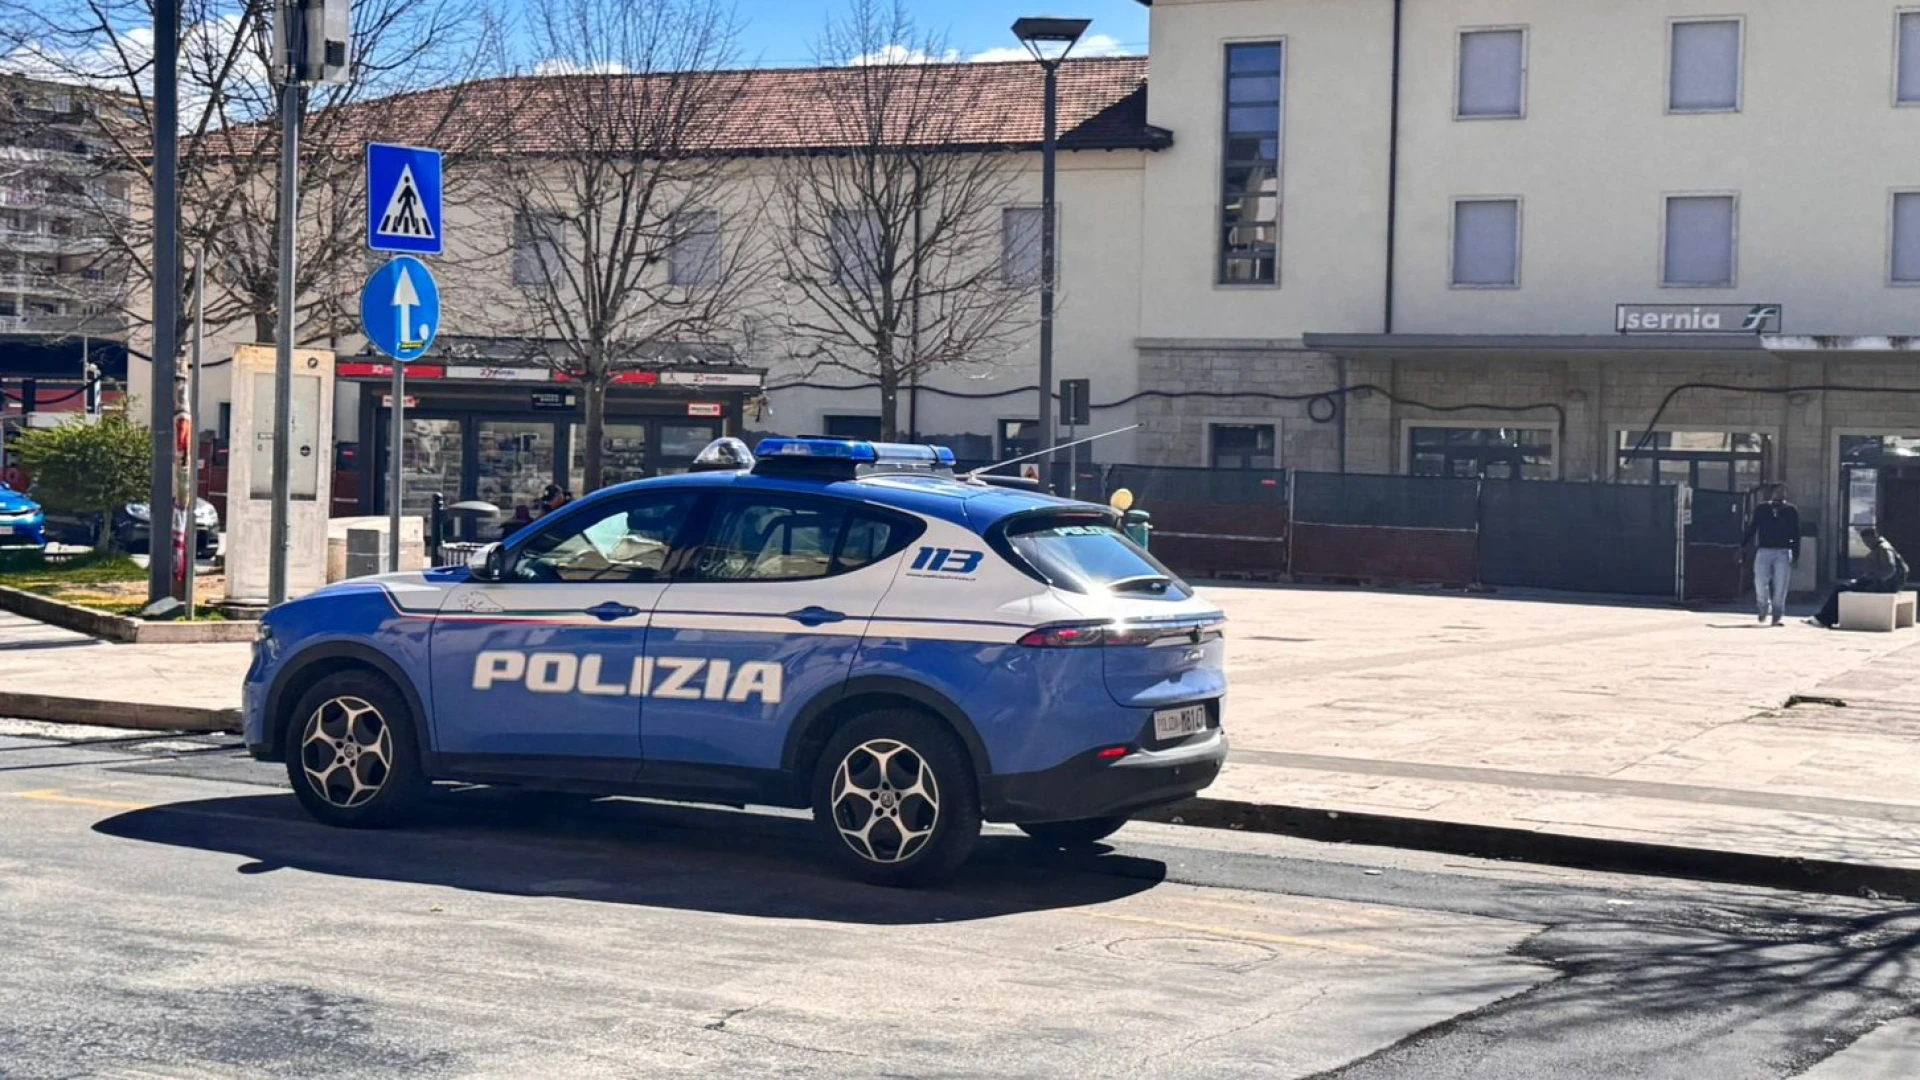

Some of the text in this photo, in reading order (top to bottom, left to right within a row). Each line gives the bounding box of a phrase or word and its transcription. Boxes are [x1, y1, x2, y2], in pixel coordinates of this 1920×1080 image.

[1618, 306, 1720, 329] Isernia
[910, 547, 984, 574] 113
[472, 651, 783, 703] POLIZIA
